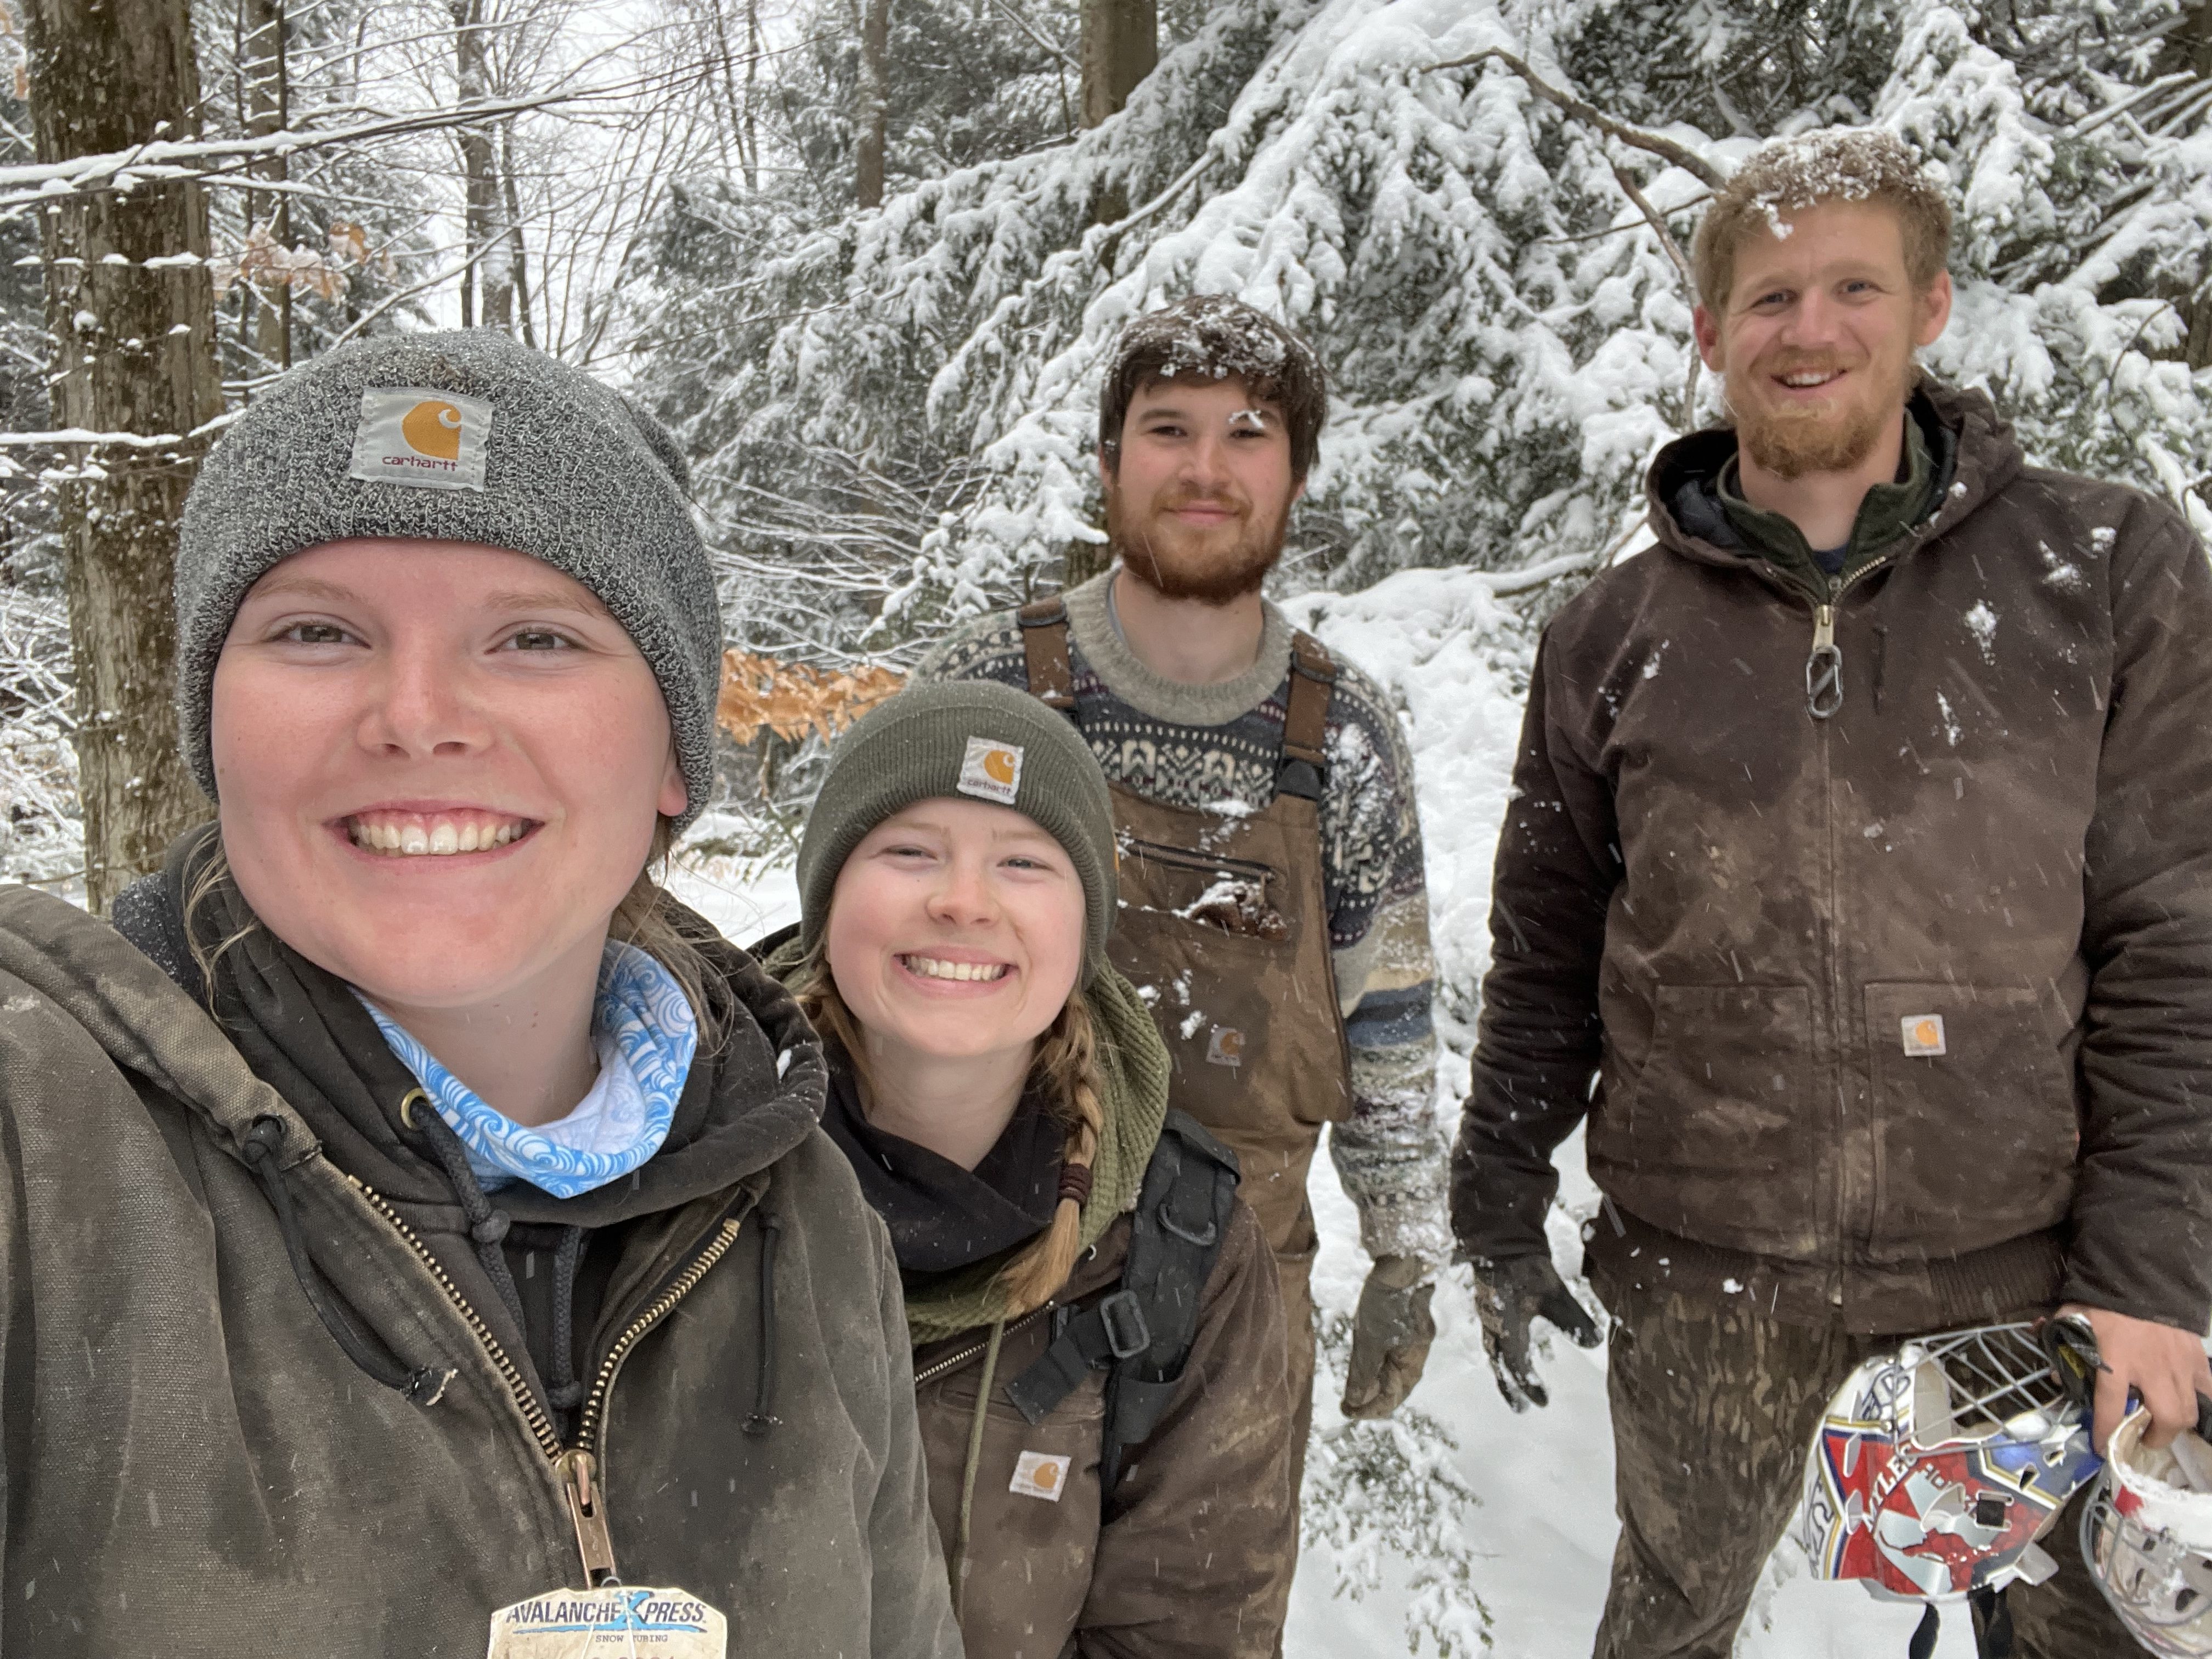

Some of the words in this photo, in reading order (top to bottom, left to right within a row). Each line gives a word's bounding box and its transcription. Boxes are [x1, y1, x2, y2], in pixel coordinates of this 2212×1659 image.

[382, 455, 458, 471] carhartt
[968, 779, 1011, 794] carhartt
[595, 1634, 624, 1643] SNOW
[632, 1634, 668, 1643] TUBING
